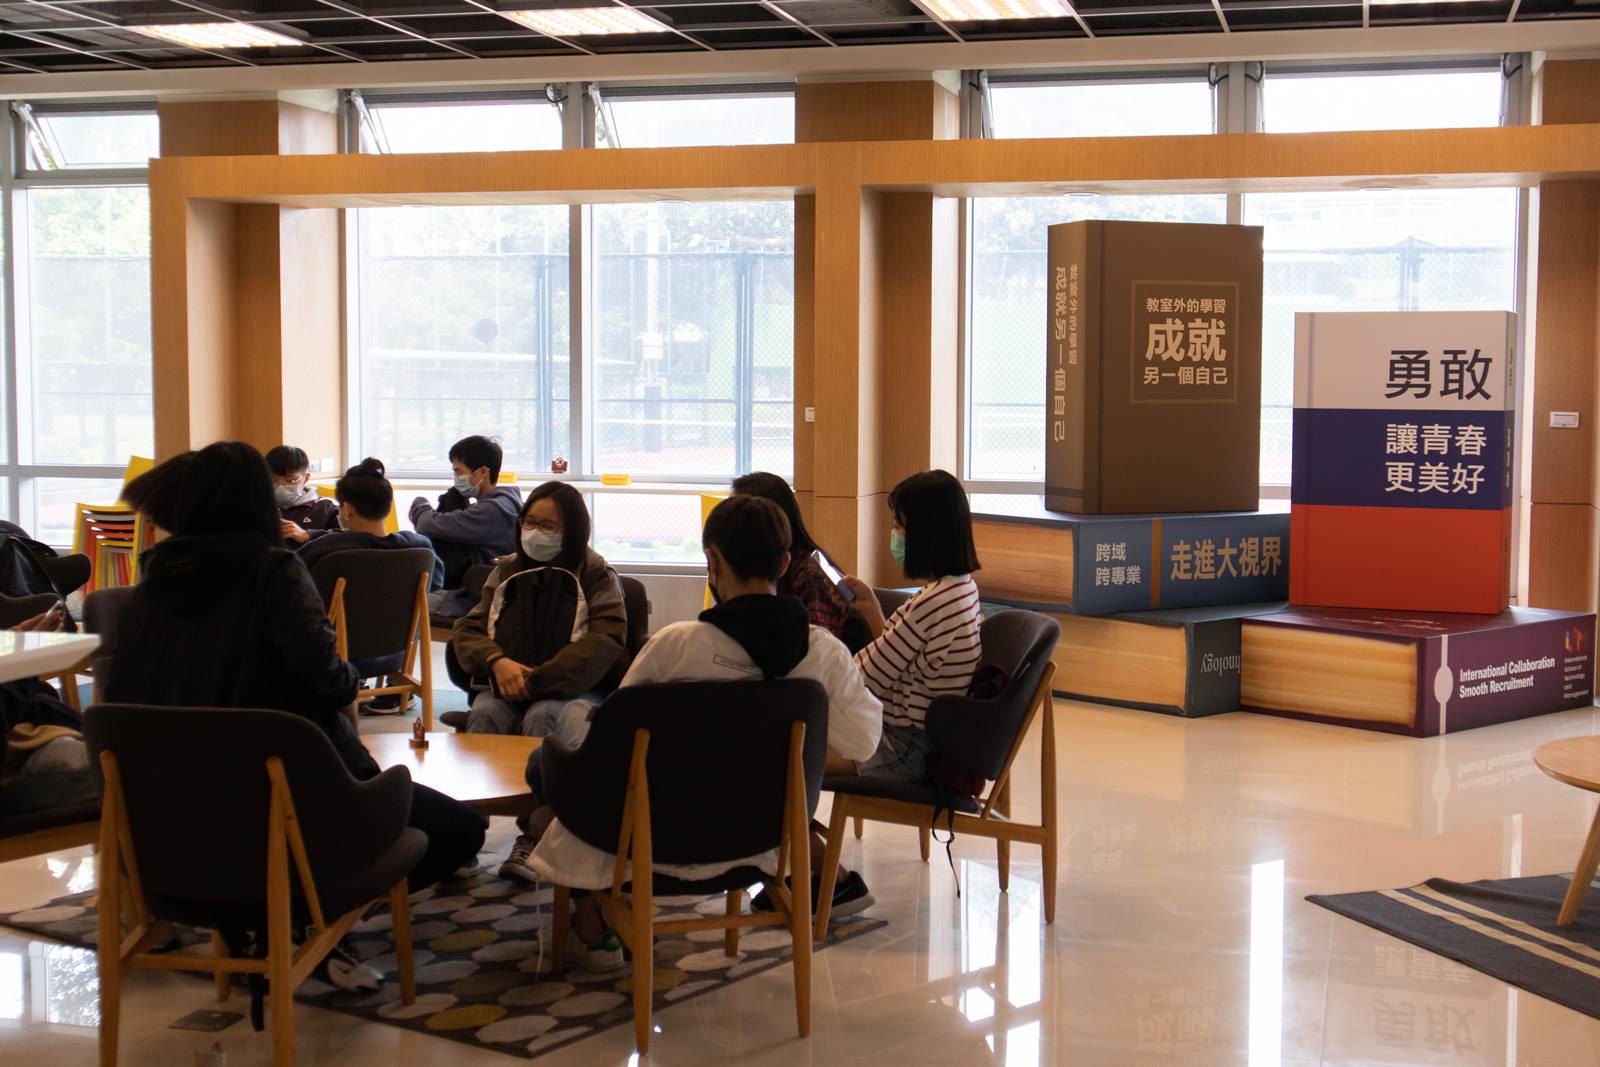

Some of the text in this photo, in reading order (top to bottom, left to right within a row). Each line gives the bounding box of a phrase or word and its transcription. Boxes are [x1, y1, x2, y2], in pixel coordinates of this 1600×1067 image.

[1146, 297, 1226, 313] 教室外的學習
[1145, 317, 1227, 362] 成就
[1143, 366, 1228, 385] 另一個自己
[1384, 348, 1493, 400] 勇敢
[1386, 423, 1488, 456] 讓青春
[1384, 461, 1486, 495] 更美好
[1095, 542, 1127, 563] 跨域
[1170, 536, 1282, 582] 走進大視界
[1095, 565, 1141, 586] 跨專業
[1200, 653, 1241, 677] hnology
[1460, 656, 1556, 683] International Collaboration
[1459, 675, 1534, 699] Smooth Recruitment
